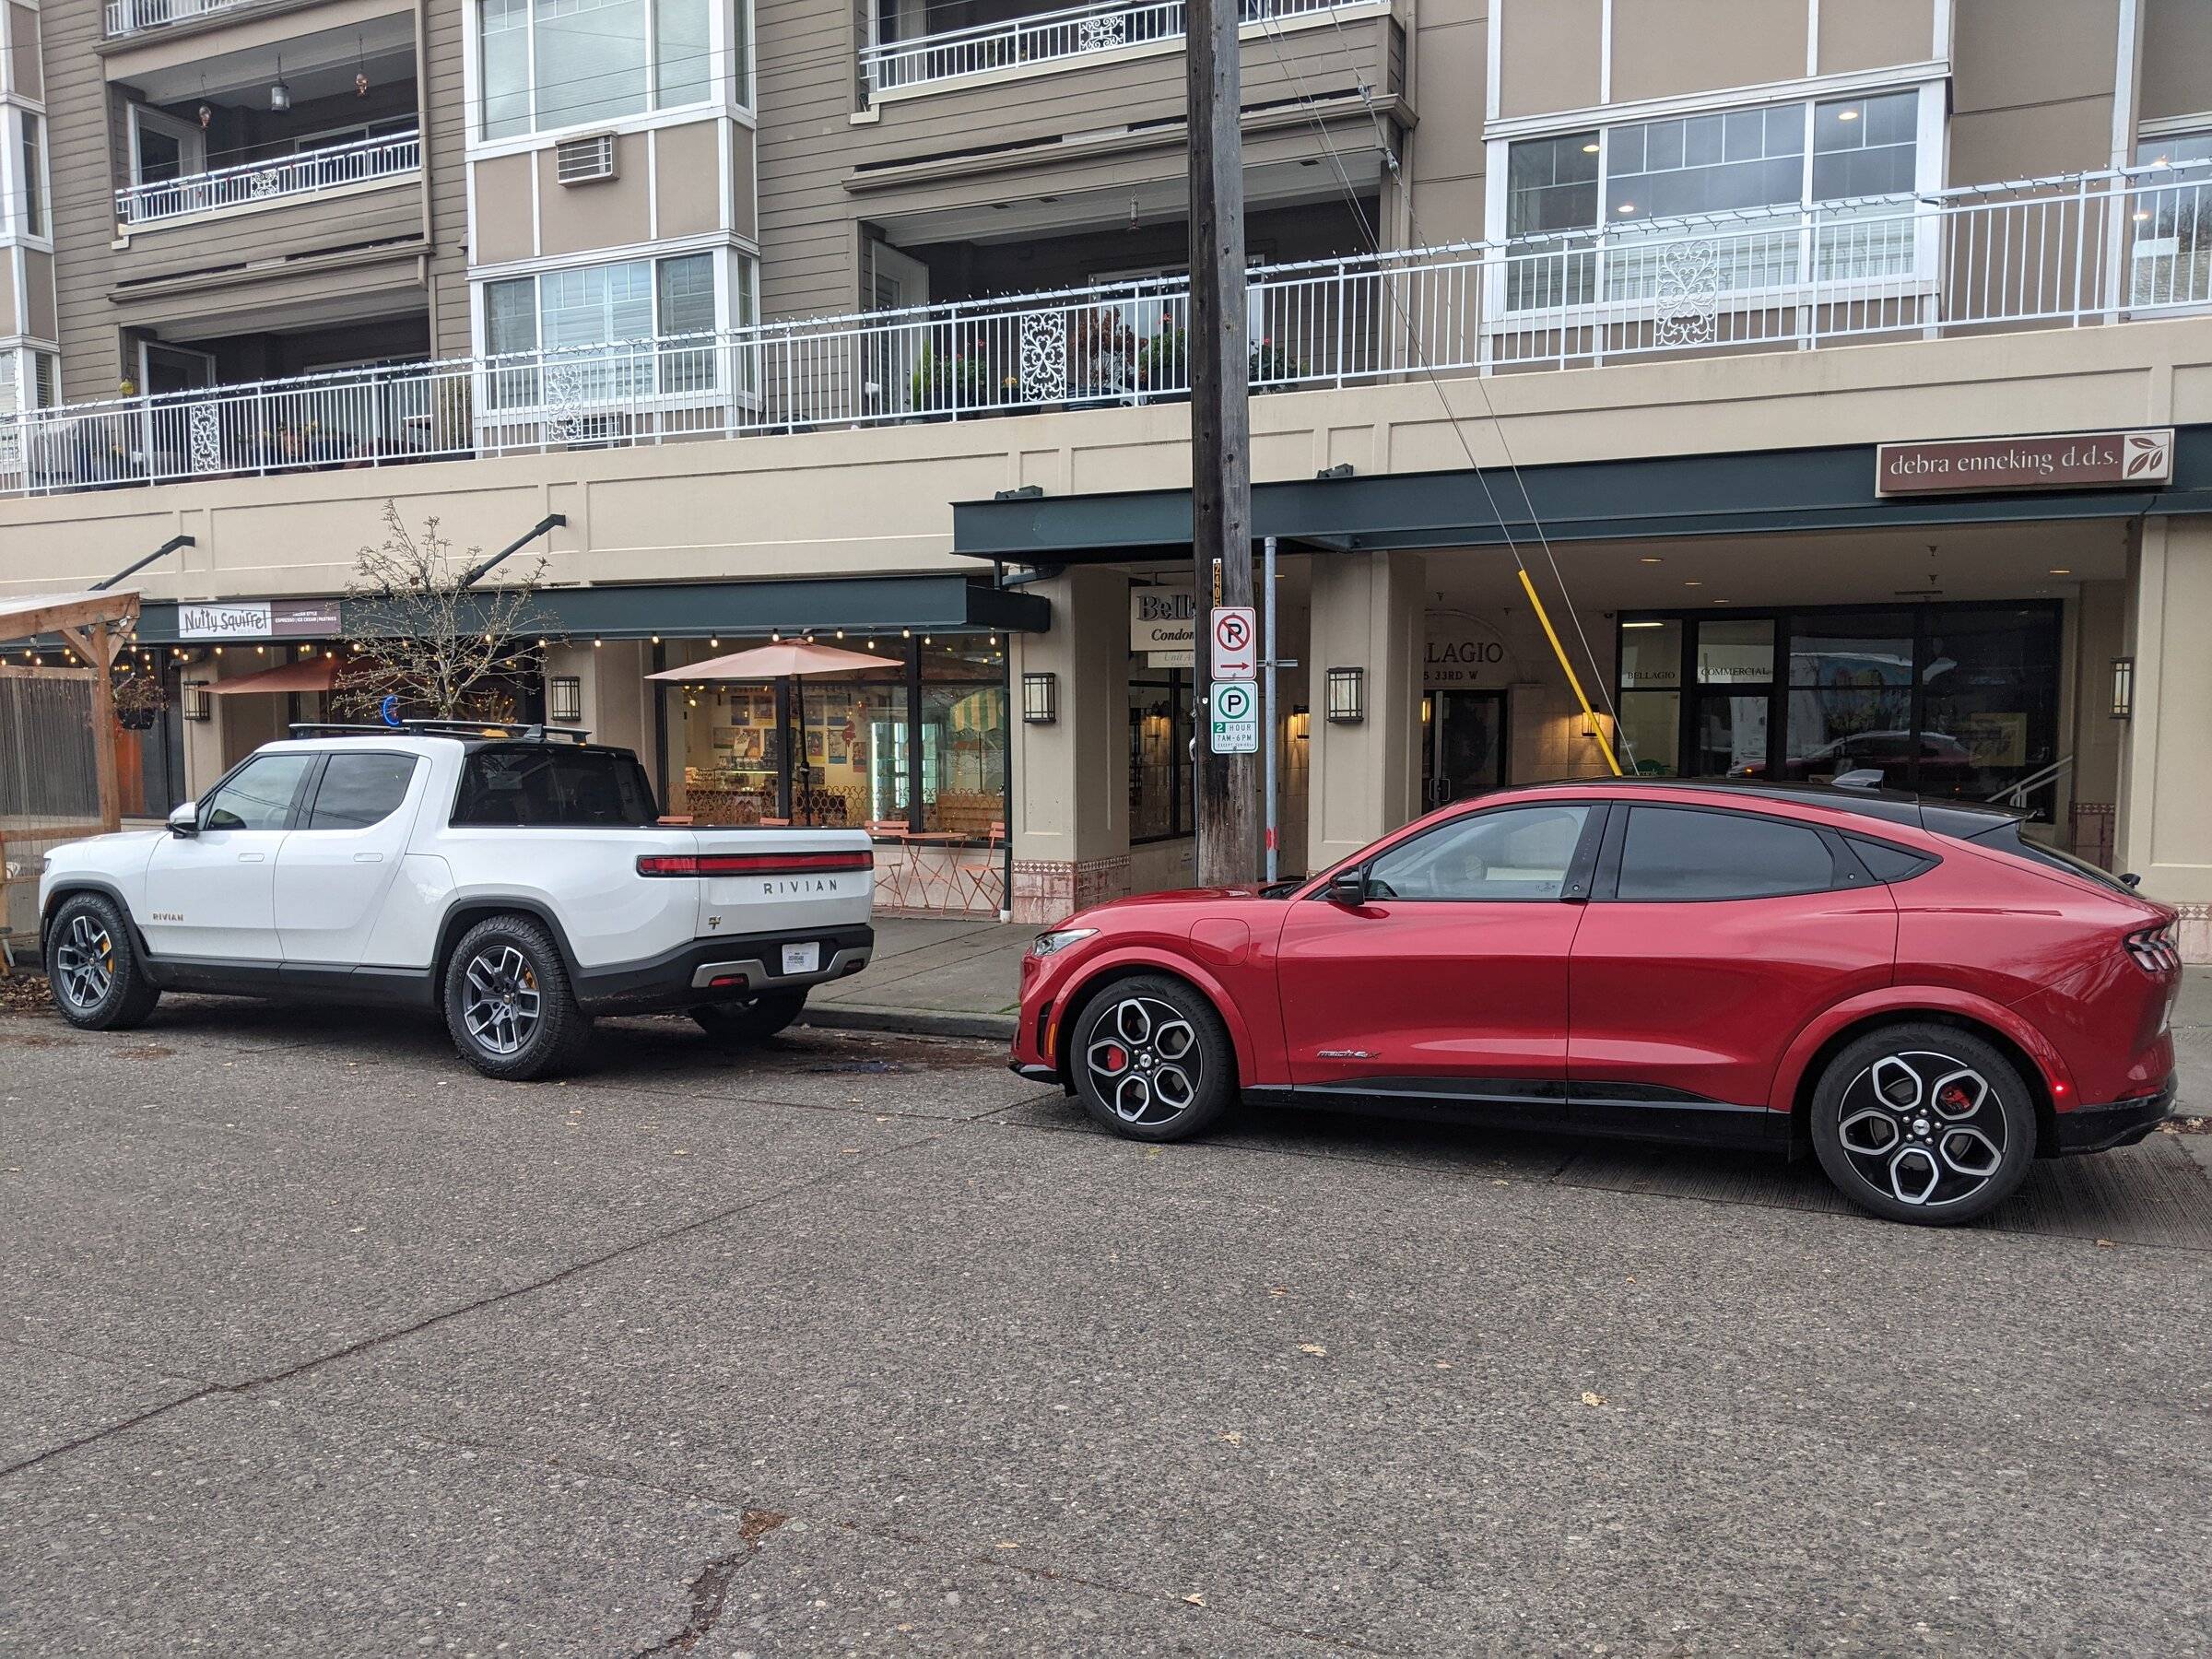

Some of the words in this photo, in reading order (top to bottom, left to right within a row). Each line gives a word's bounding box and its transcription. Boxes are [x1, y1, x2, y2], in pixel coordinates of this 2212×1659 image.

[1889, 454, 1949, 476] debra
[1958, 449, 2054, 475] enneking
[2061, 446, 2119, 467] d.d.s.
[1136, 595, 1194, 621] Bell
[184, 608, 218, 632] Nutty
[220, 609, 267, 631] Squirrel
[1424, 642, 1504, 663] LAGIO
[1435, 671, 1463, 680] 33RD
[1468, 671, 1478, 680] W
[1628, 671, 1676, 680] BELLAGIO
[1700, 667, 1770, 677] COMMERCIAL
[1228, 695, 1241, 712] P
[1217, 724, 1223, 732] 2
[1230, 724, 1252, 732] HOUR
[1217, 734, 1252, 742] 7AM-6PM
[763, 879, 837, 895] RIVIAN
[152, 912, 183, 922] RIVIAN
